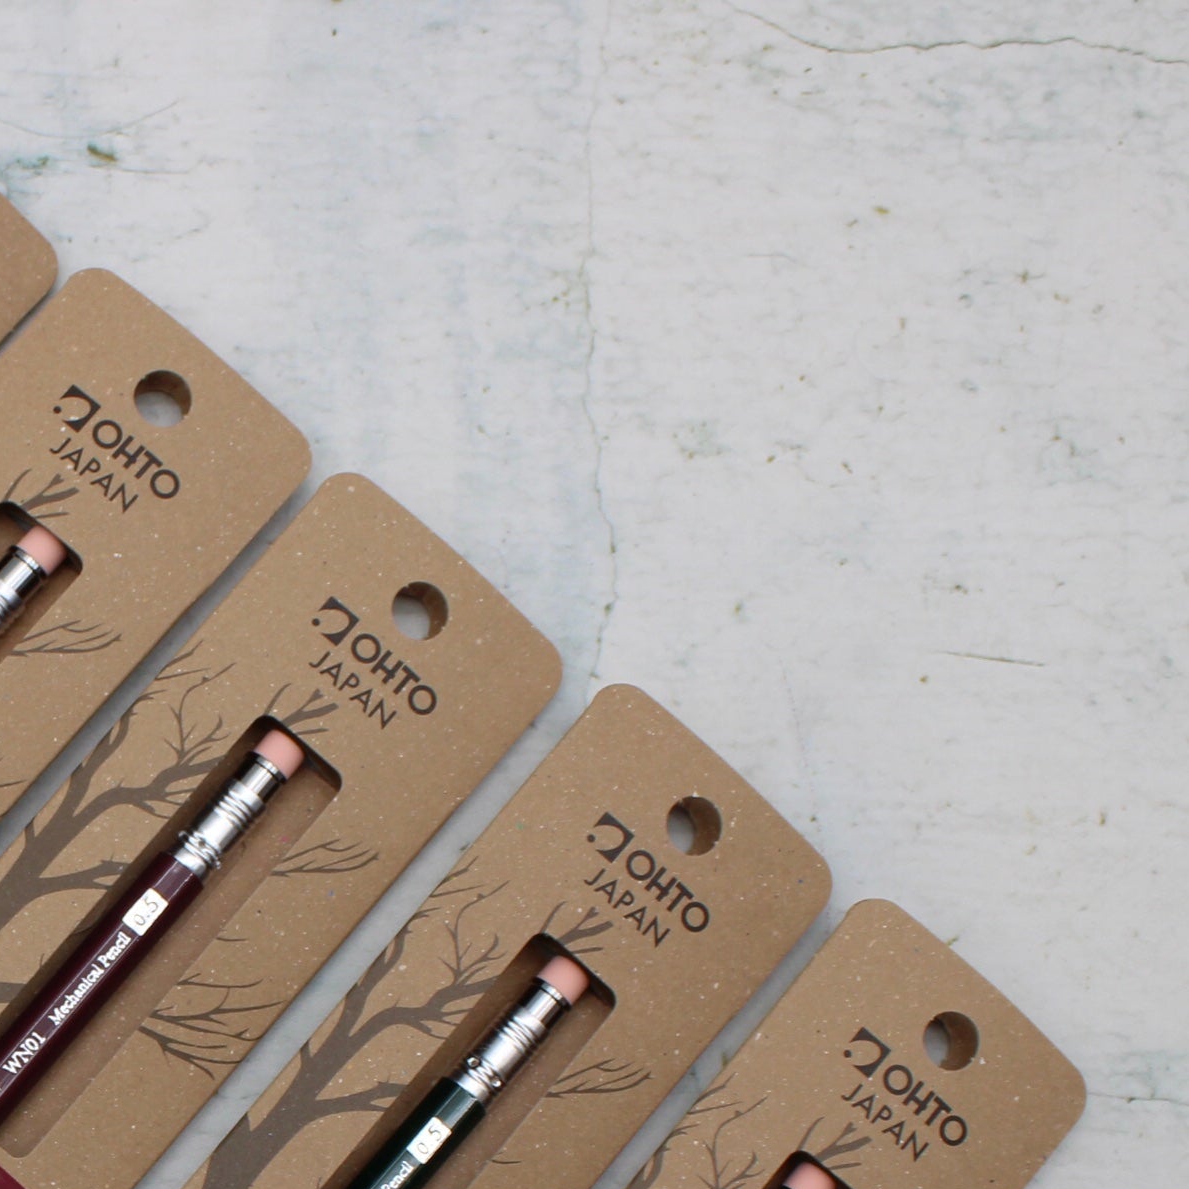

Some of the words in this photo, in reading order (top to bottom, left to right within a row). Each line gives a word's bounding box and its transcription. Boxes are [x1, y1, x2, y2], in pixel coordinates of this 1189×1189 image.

[48, 436, 139, 514] JAPAN
[91, 418, 180, 499] OHTO
[307, 651, 397, 730] JAPAN
[350, 632, 438, 715] OHTO
[582, 869, 671, 948] JAPAN
[624, 849, 711, 932] OHTO
[0, 1029, 47, 1076] WN01
[46, 961, 106, 1027] Mechanical
[96, 929, 133, 969] Pencil
[840, 1084, 930, 1162] JAPAN
[882, 1063, 969, 1146] OHTO
